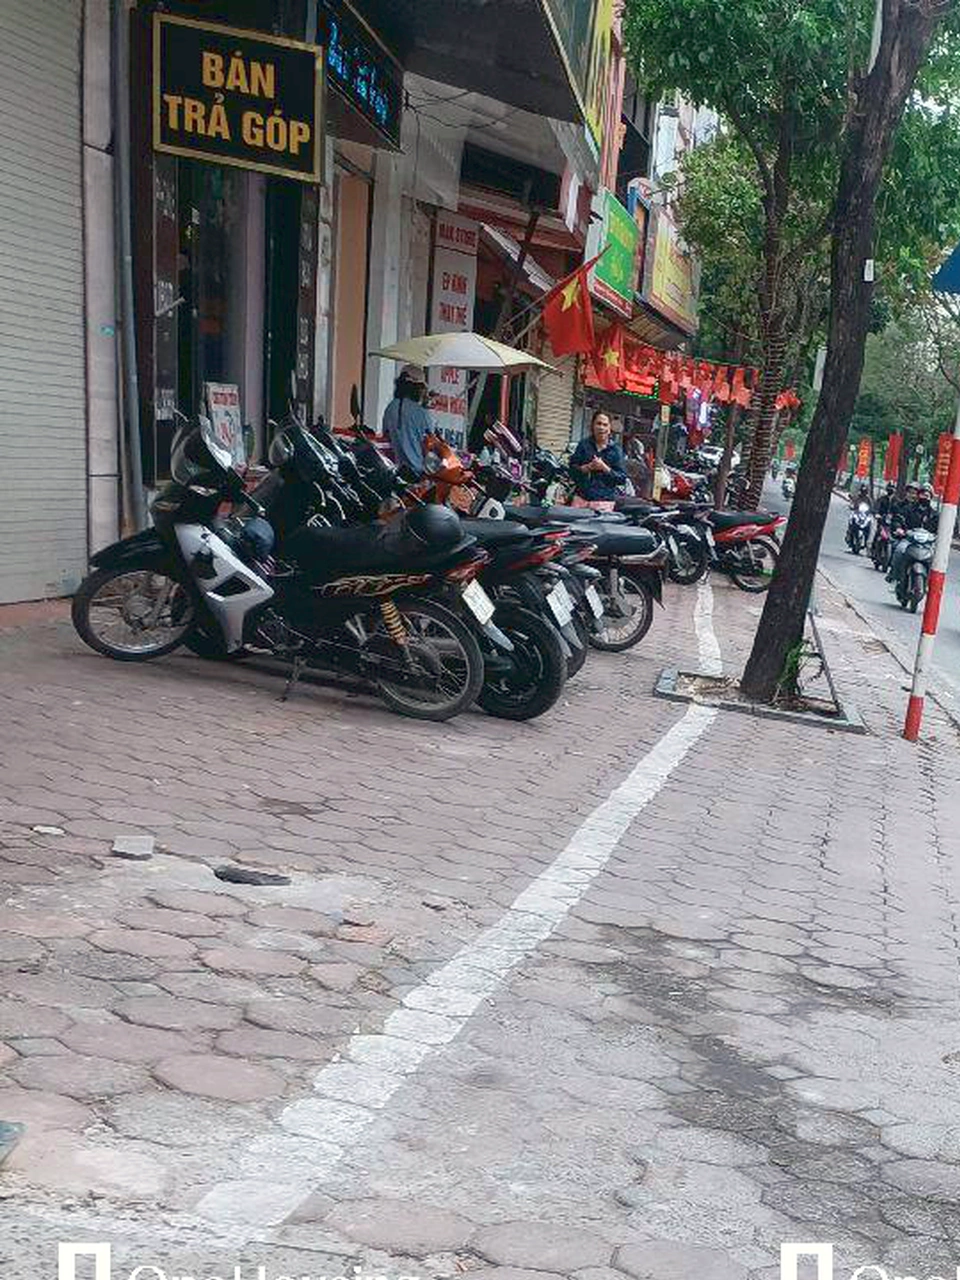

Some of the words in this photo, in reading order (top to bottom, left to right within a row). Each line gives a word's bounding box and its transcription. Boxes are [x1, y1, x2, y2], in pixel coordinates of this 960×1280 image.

[202, 51, 275, 99] BÁN
[163, 91, 231, 141] TRẢ
[242, 106, 311, 155] GÓP
